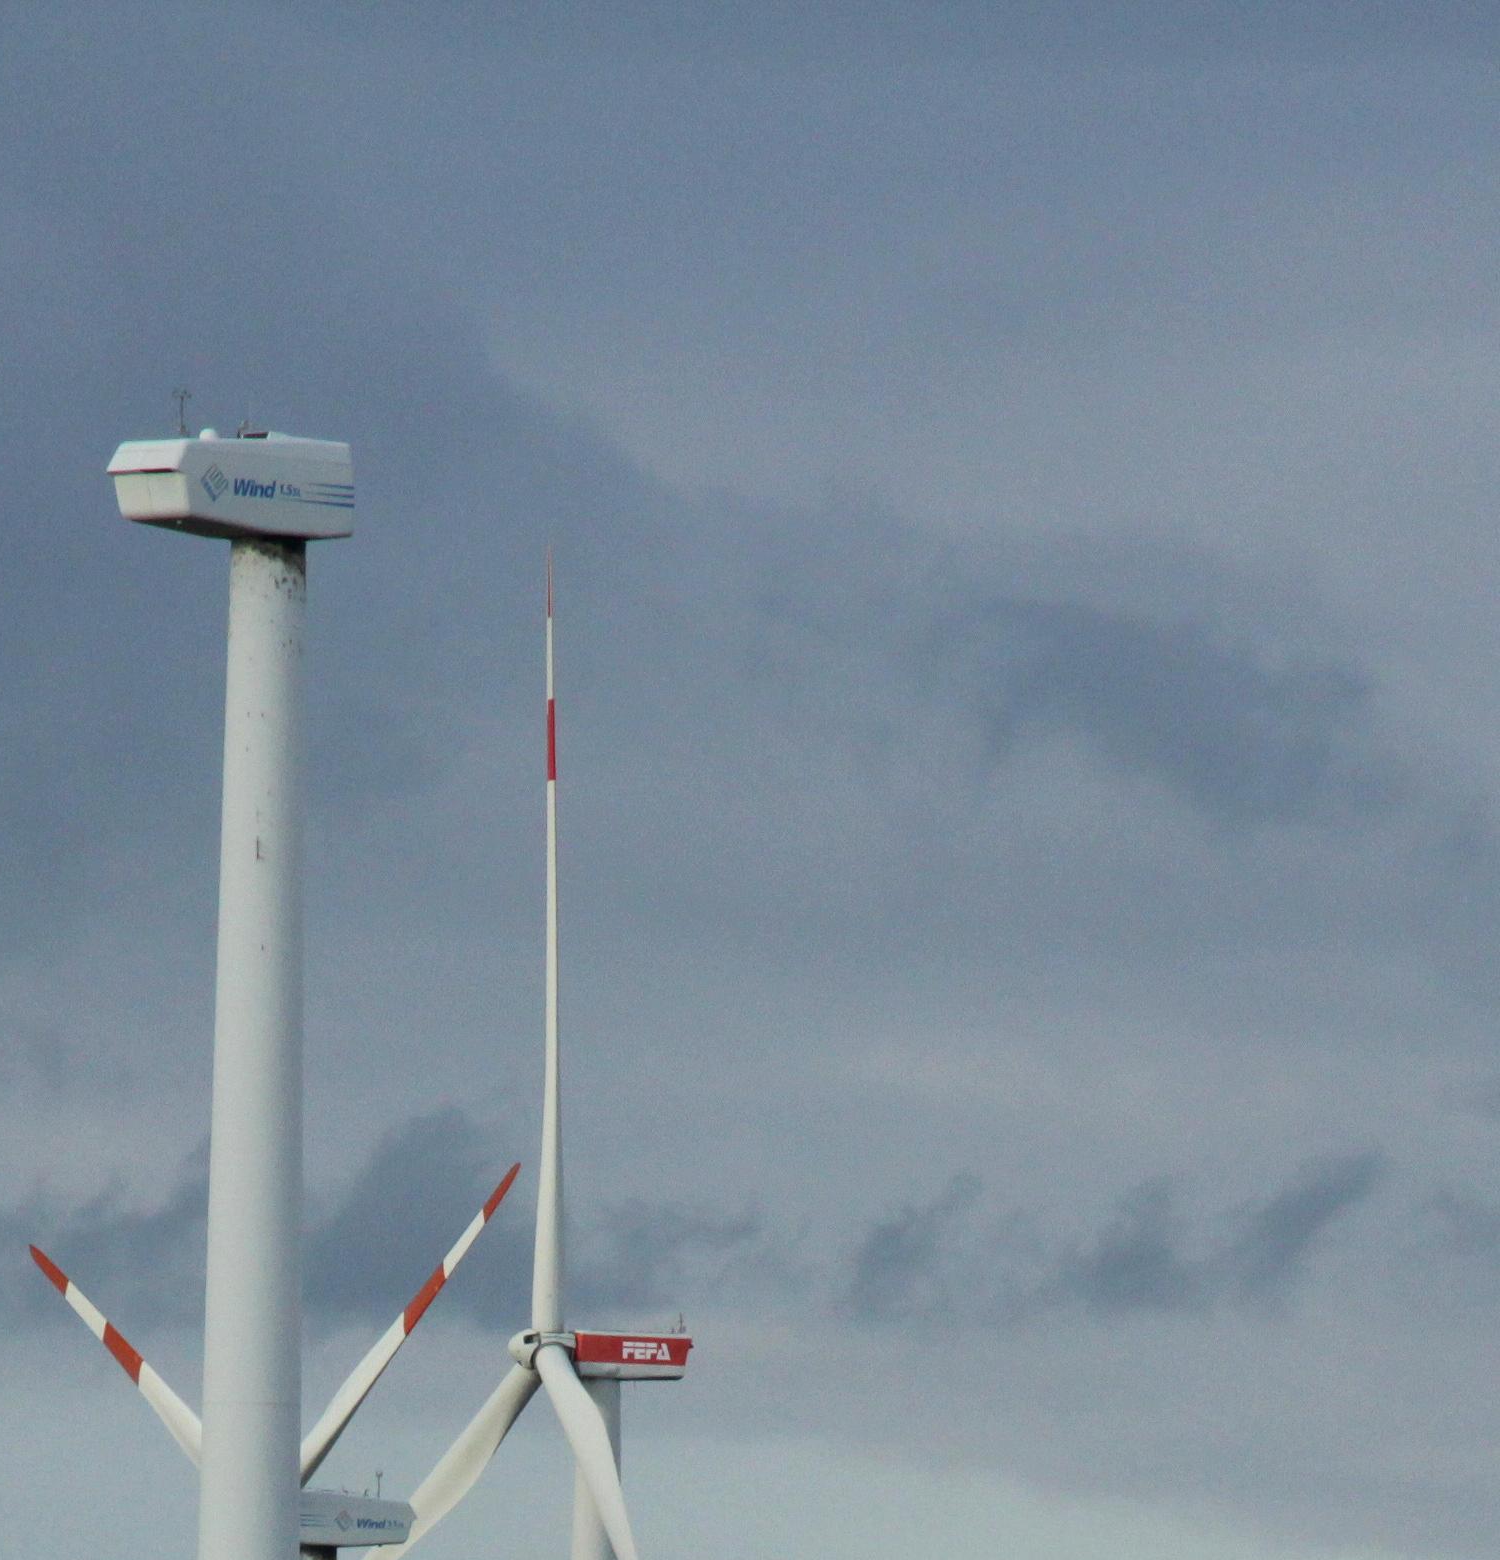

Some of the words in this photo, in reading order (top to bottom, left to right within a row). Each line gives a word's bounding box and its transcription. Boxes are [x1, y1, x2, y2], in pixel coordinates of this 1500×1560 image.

[234, 478, 276, 498] Wind
[622, 1341, 671, 1361] FEFA
[356, 1518, 387, 1529] Wind
